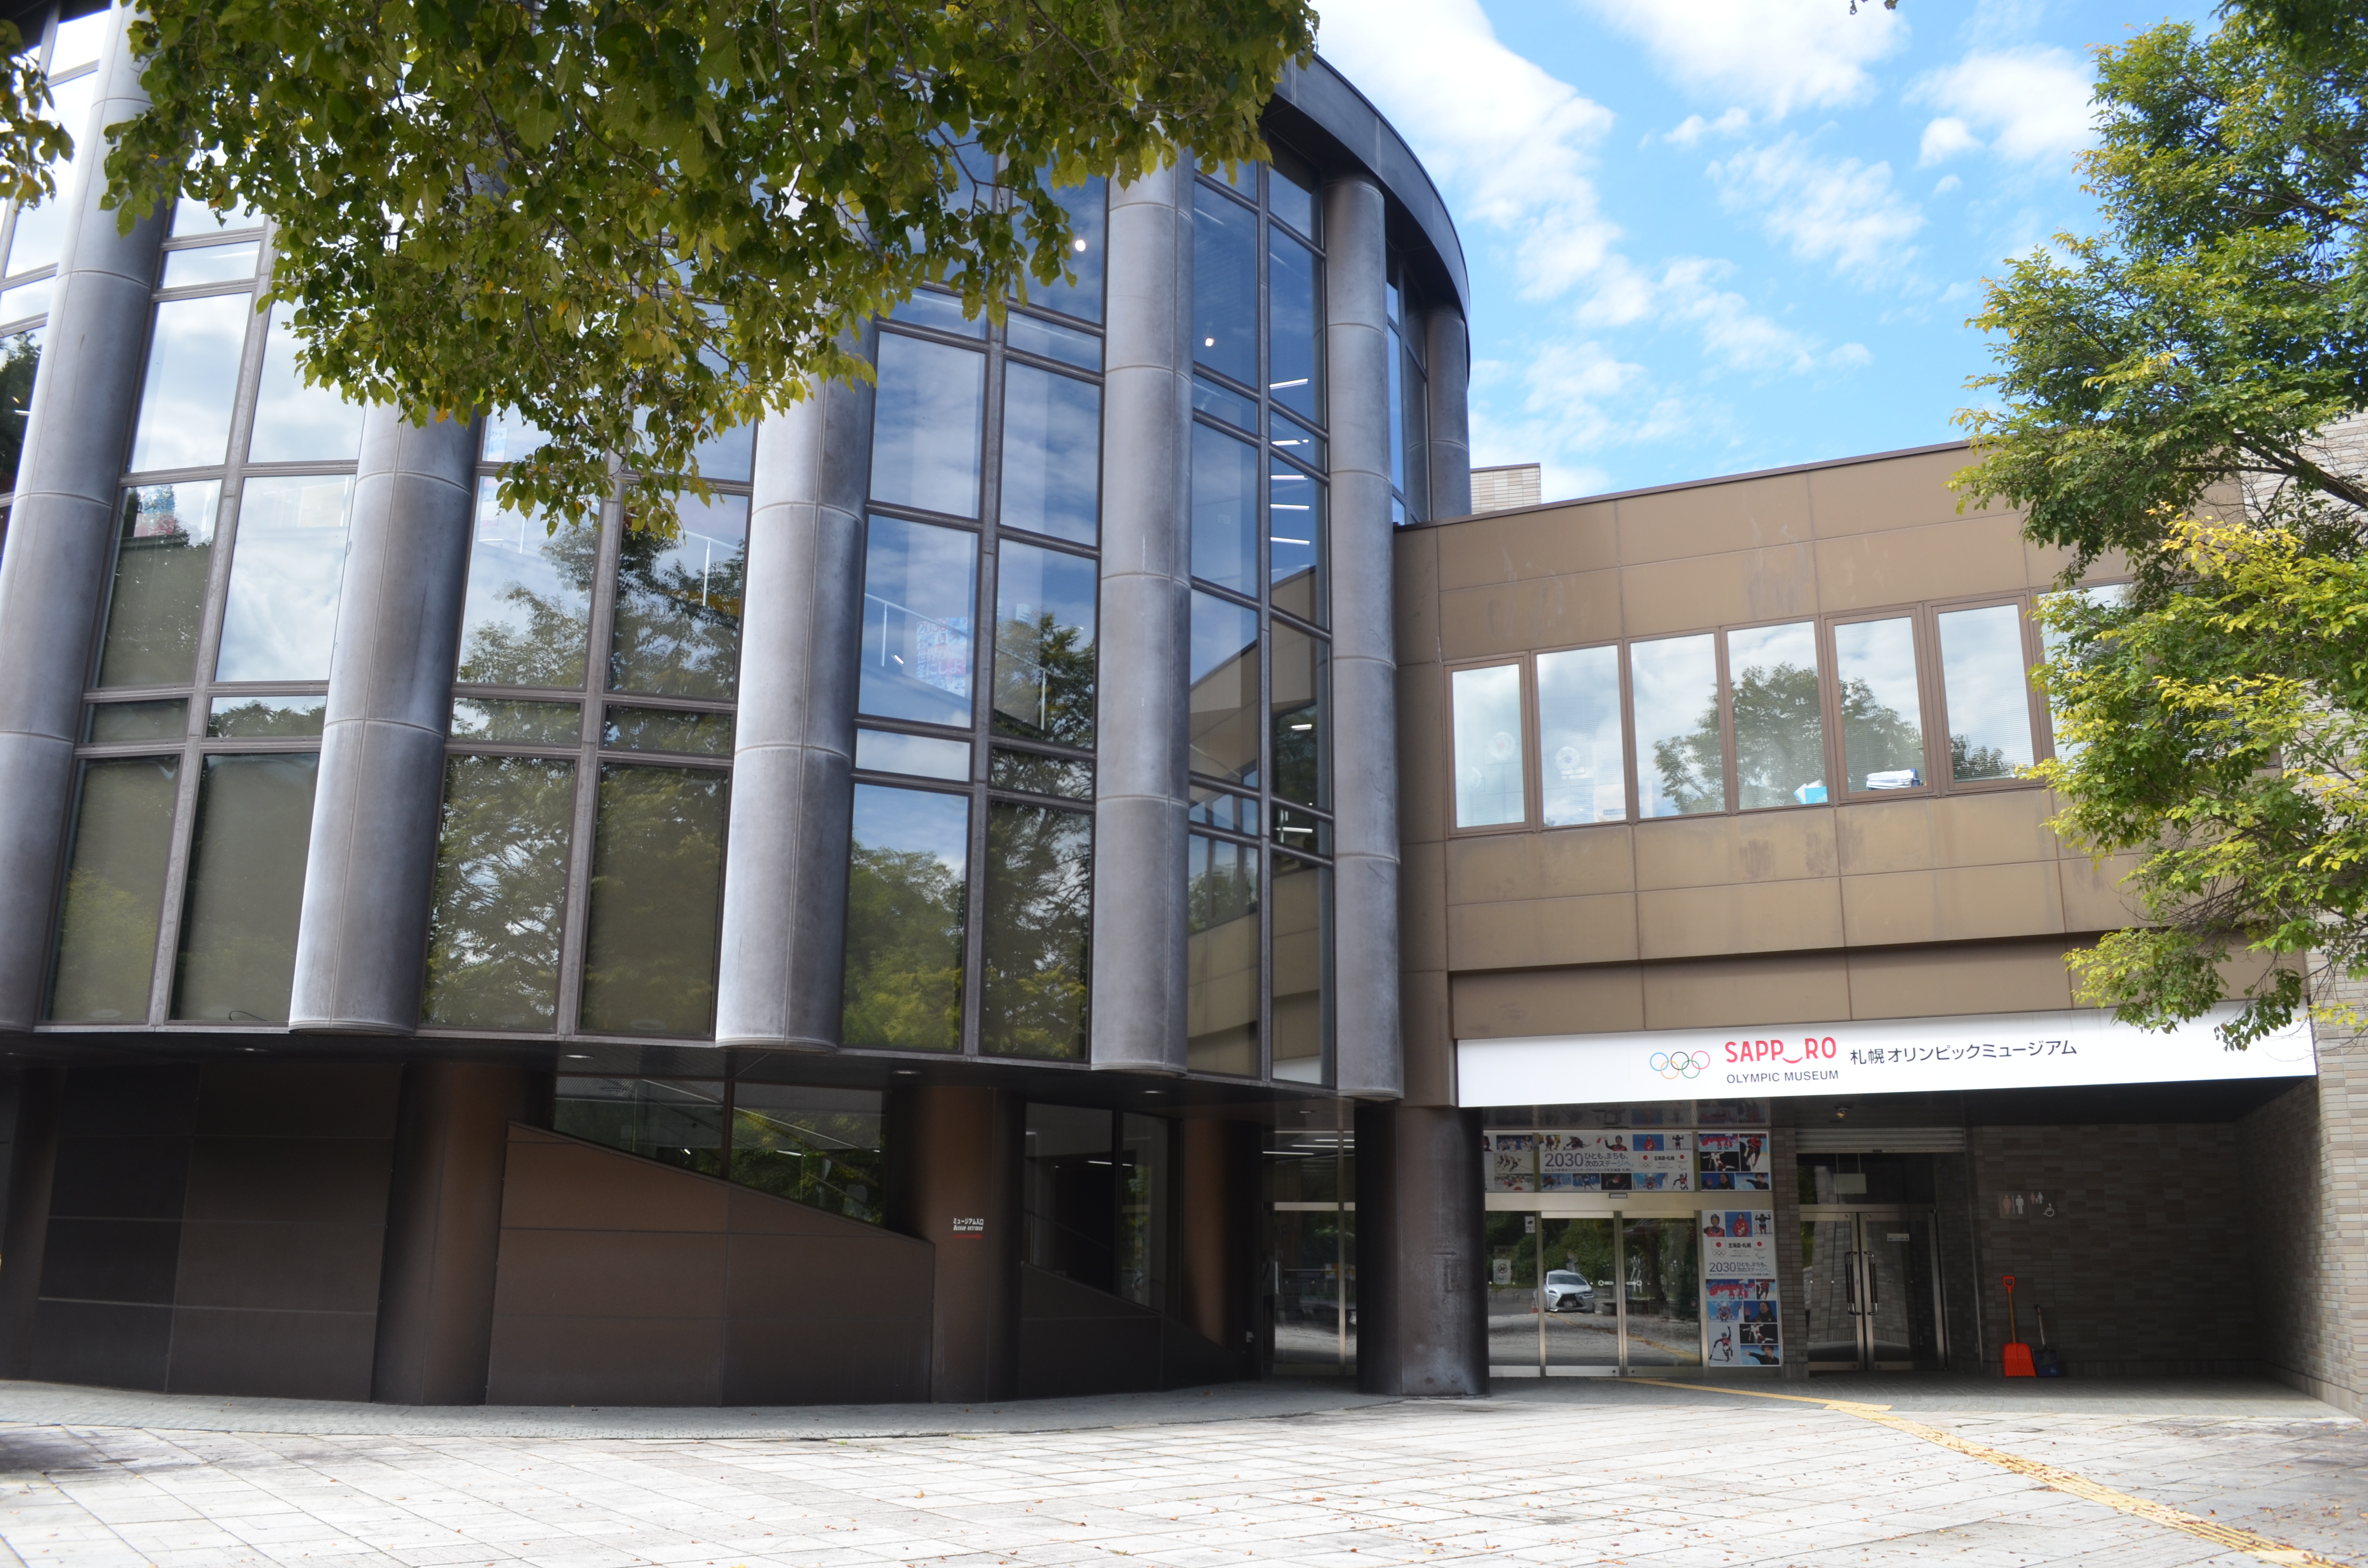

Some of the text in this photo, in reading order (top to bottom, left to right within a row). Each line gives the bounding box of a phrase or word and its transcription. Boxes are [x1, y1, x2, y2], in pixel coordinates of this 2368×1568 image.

[1850, 1040, 2077, 1065] 札幌オリンピックミュージアム
[1727, 1070, 1839, 1084] OLYMPIC MUSEUM
[1544, 1152, 1584, 1167] 2030
[953, 1217, 984, 1225] ミュージアム入口
[1709, 1262, 1736, 1273] 2030
